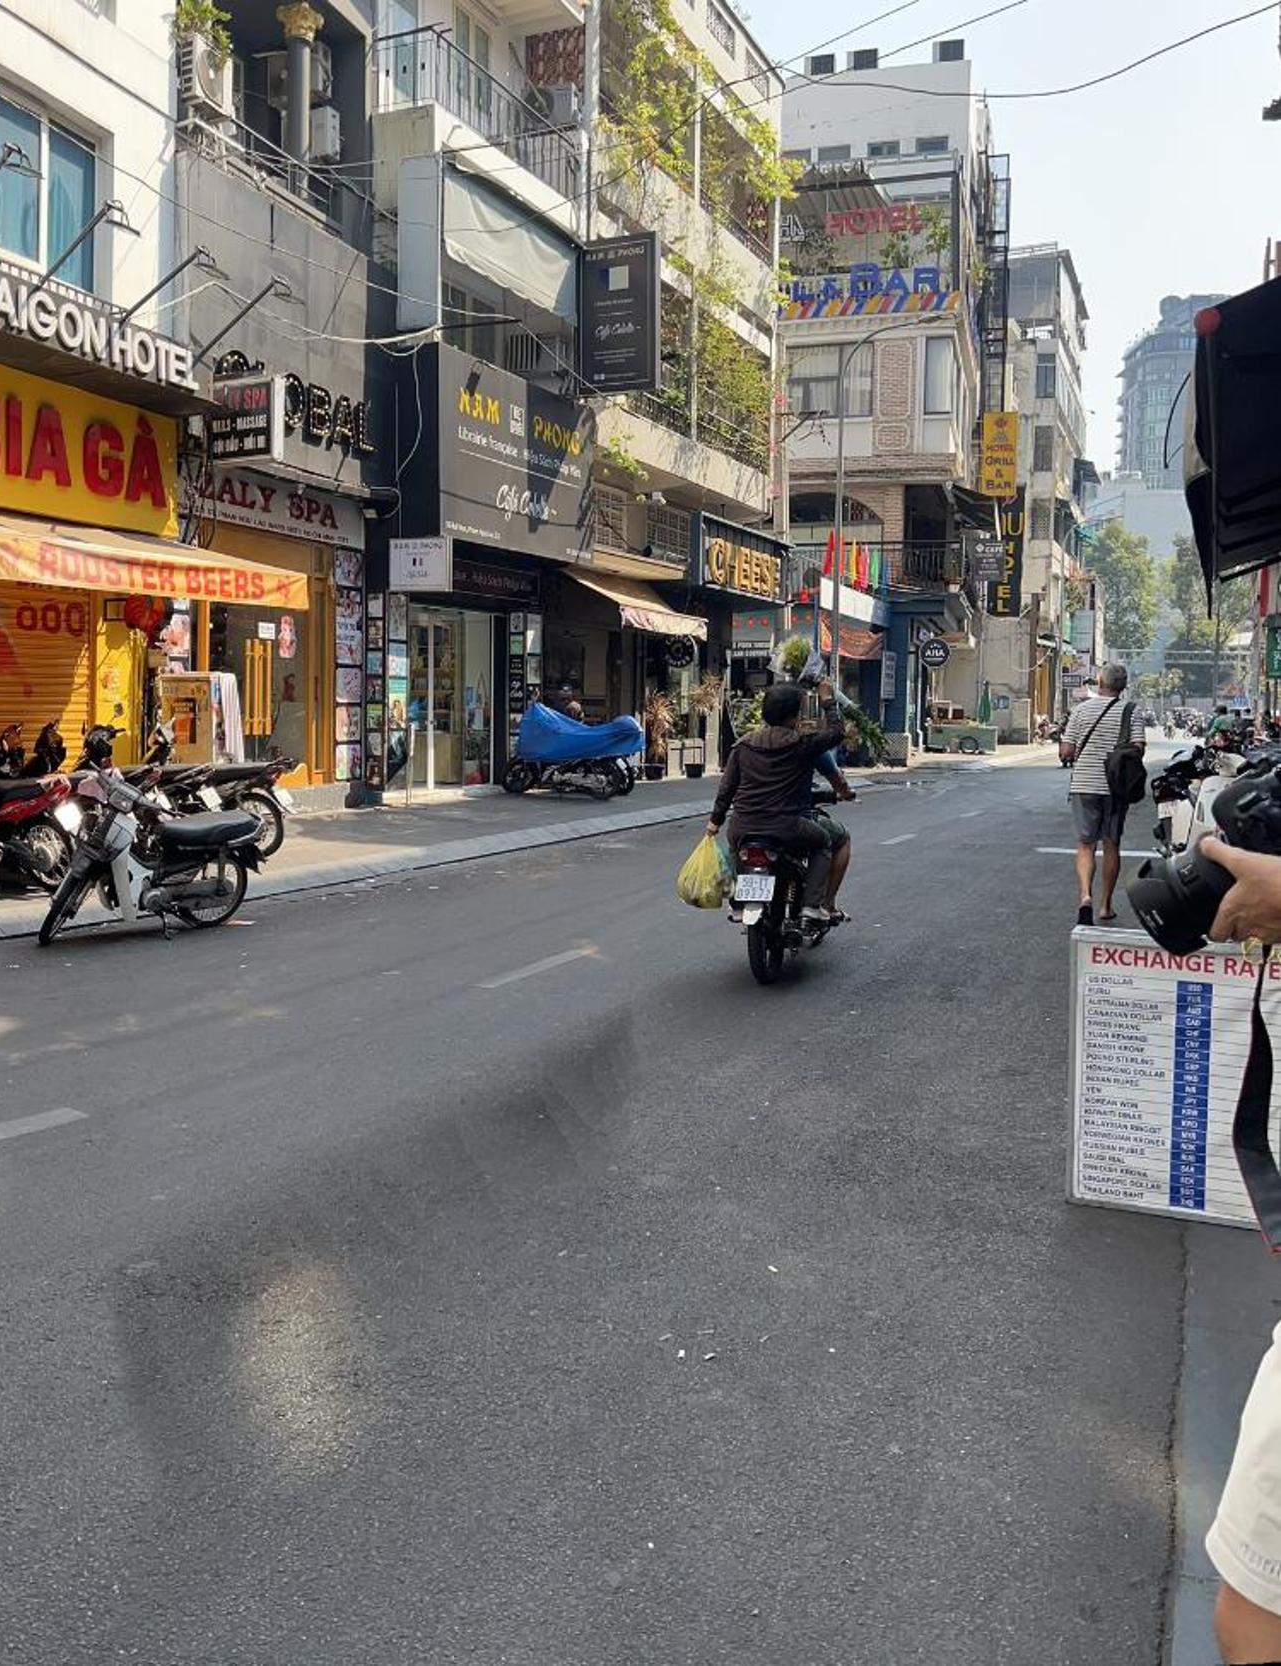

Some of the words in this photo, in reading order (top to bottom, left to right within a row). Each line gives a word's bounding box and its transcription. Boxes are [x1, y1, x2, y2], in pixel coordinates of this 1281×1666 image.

[111, 320, 200, 391] HOTEL
[243, 387, 270, 412] SPA
[236, 415, 267, 431] MASSAGE
[533, 415, 582, 456] PHONG
[81, 415, 168, 510] GÀ
[985, 456, 1014, 466] GRILL
[986, 480, 1013, 490] BAR
[288, 492, 339, 530] SPA
[38, 542, 177, 593] ROOSTER
[184, 567, 267, 601] BEERS
[1091, 946, 1215, 973] EXCHANGE
[1223, 957, 1280, 980] RAE
[1101, 977, 1133, 985] DOLLAR
[1131, 1002, 1158, 1010] DOLLAR
[1088, 1008, 1128, 1019] CANADIAN
[1130, 1012, 1162, 1021] DOLLAR
[1185, 1018, 1201, 1026] CAD
[1088, 1031, 1109, 1039] YUAN
[1184, 1040, 1199, 1049] CNY
[1133, 1069, 1166, 1078] DOLLAR
[1085, 1086, 1102, 1094] YEN
[1084, 1097, 1118, 1107] KOREAN
[1084, 1185, 1121, 1197] THAILAND
[1122, 1190, 1144, 1199] BAHT
